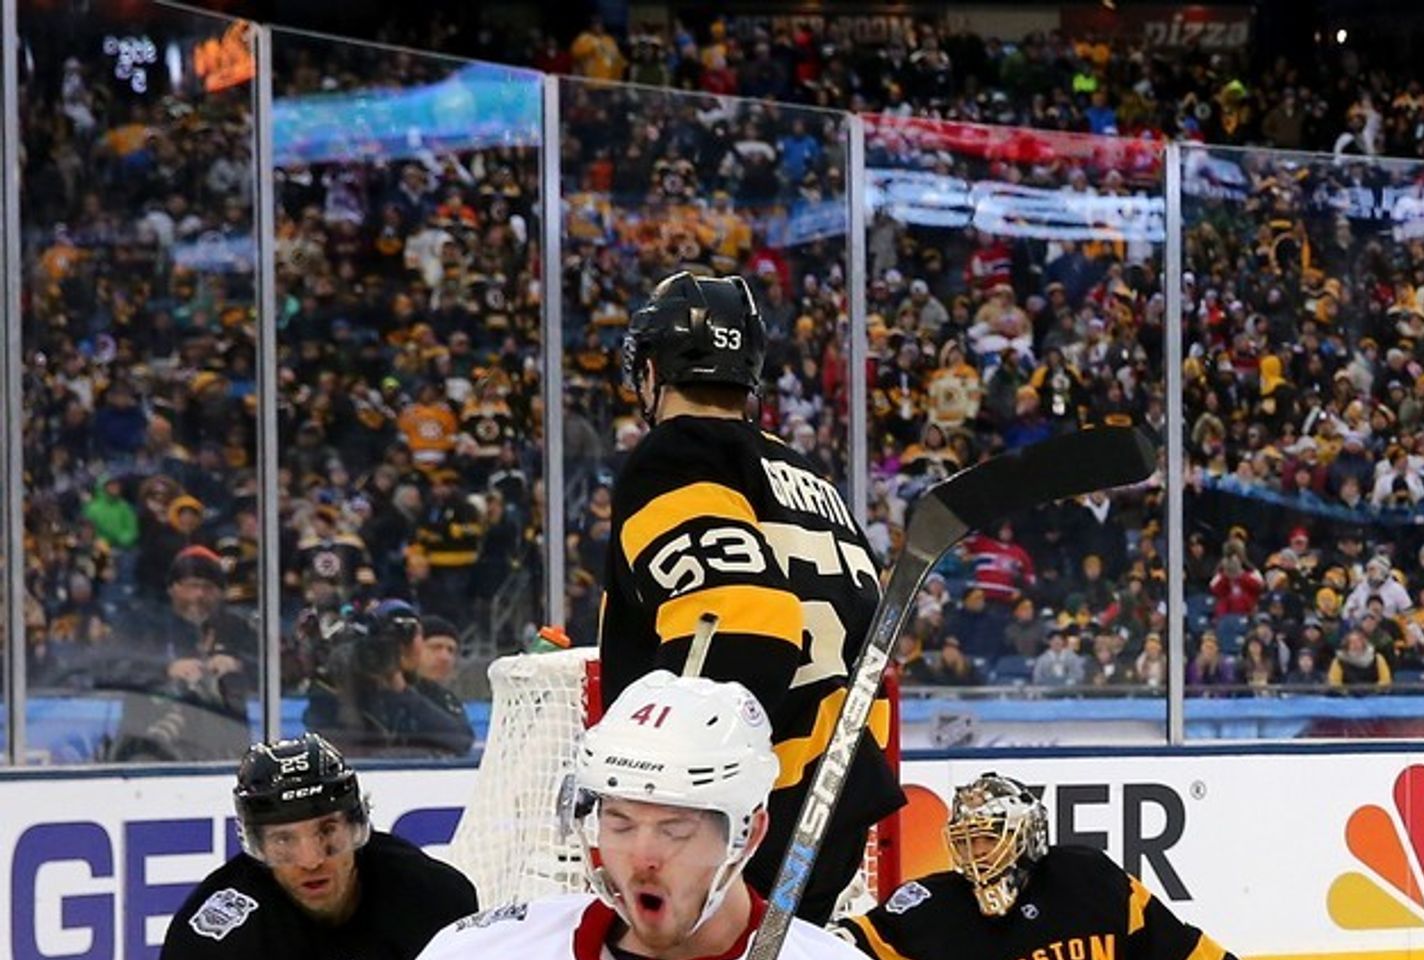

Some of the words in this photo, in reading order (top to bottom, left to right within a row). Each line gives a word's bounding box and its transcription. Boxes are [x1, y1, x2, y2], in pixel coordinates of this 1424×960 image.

[713, 327, 742, 350] 53
[649, 527, 767, 598] 53
[631, 703, 672, 728] 41
[799, 643, 888, 842] NEXUS
[280, 751, 309, 774] 25
[604, 755, 665, 773] BAUER
[281, 784, 323, 801] CCM
